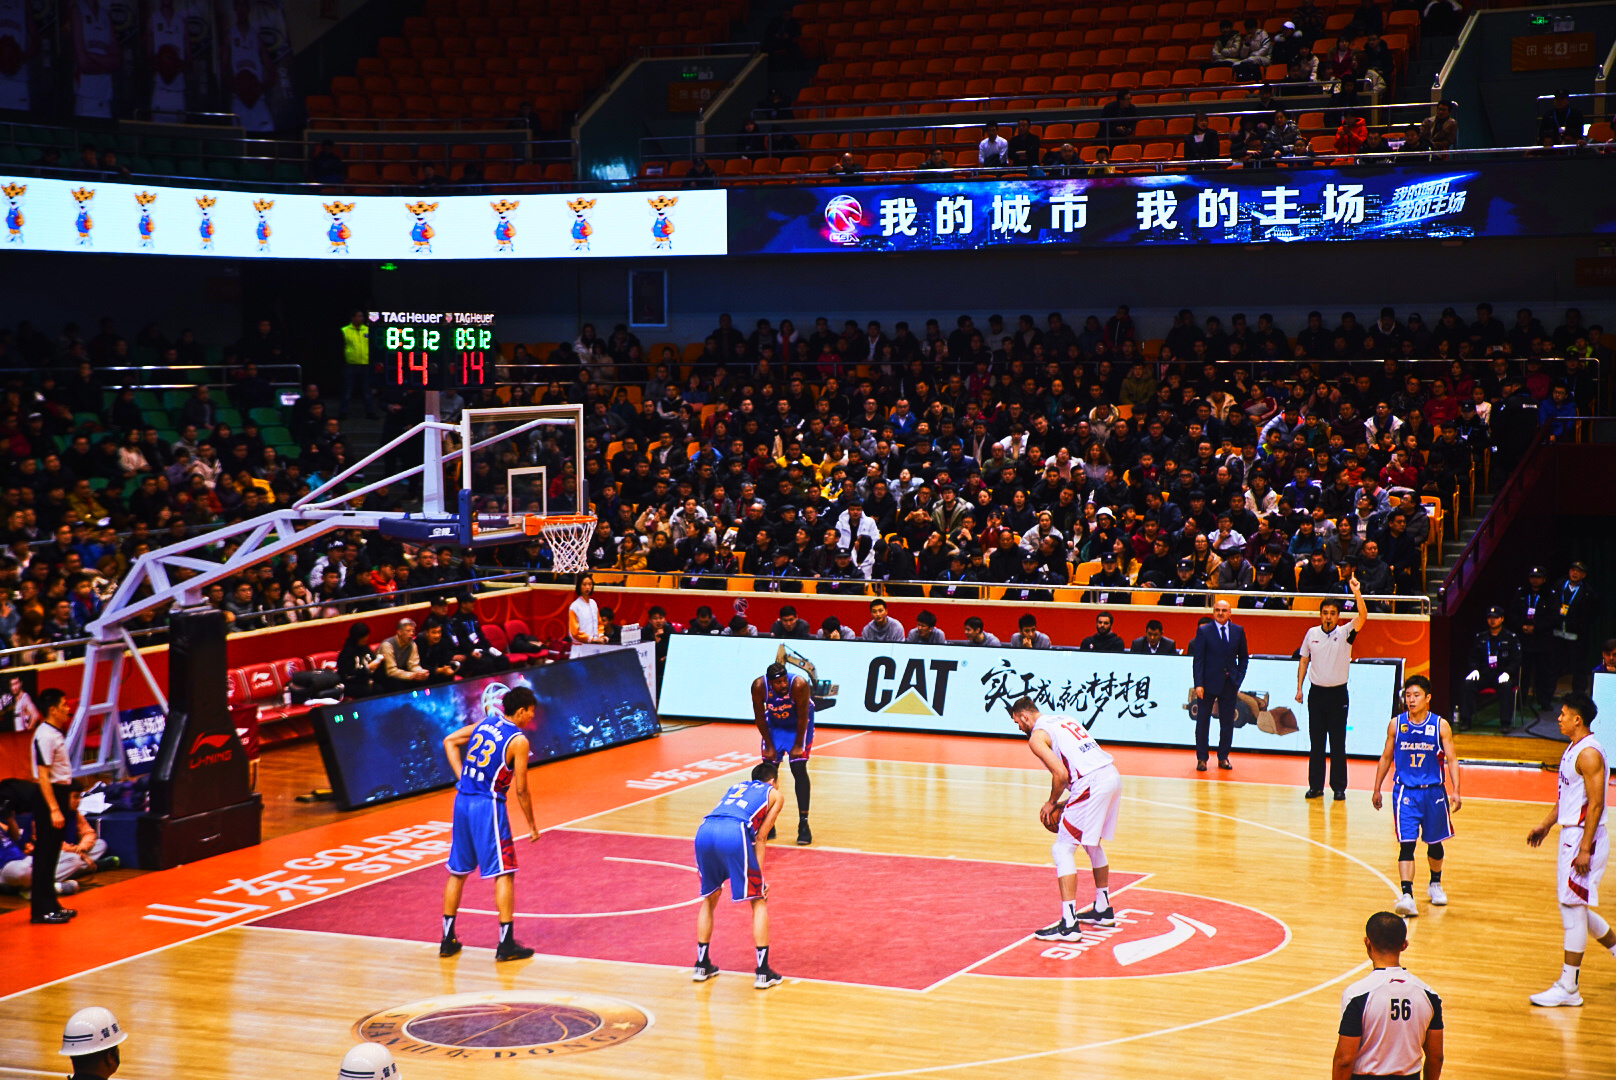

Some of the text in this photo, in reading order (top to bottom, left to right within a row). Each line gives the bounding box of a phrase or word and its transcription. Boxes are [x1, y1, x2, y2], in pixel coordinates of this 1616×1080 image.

[879, 184, 1365, 236] 我的城市 我的主场
[397, 351, 428, 385] 14
[463, 351, 484, 385] 14
[864, 655, 958, 717] CAT
[1060, 721, 1089, 741] 12
[466, 733, 497, 768] 23
[1409, 752, 1426, 767] 17
[283, 820, 453, 871] GOLDEN
[142, 869, 346, 927] 山东
[1390, 998, 1412, 1021] 56
